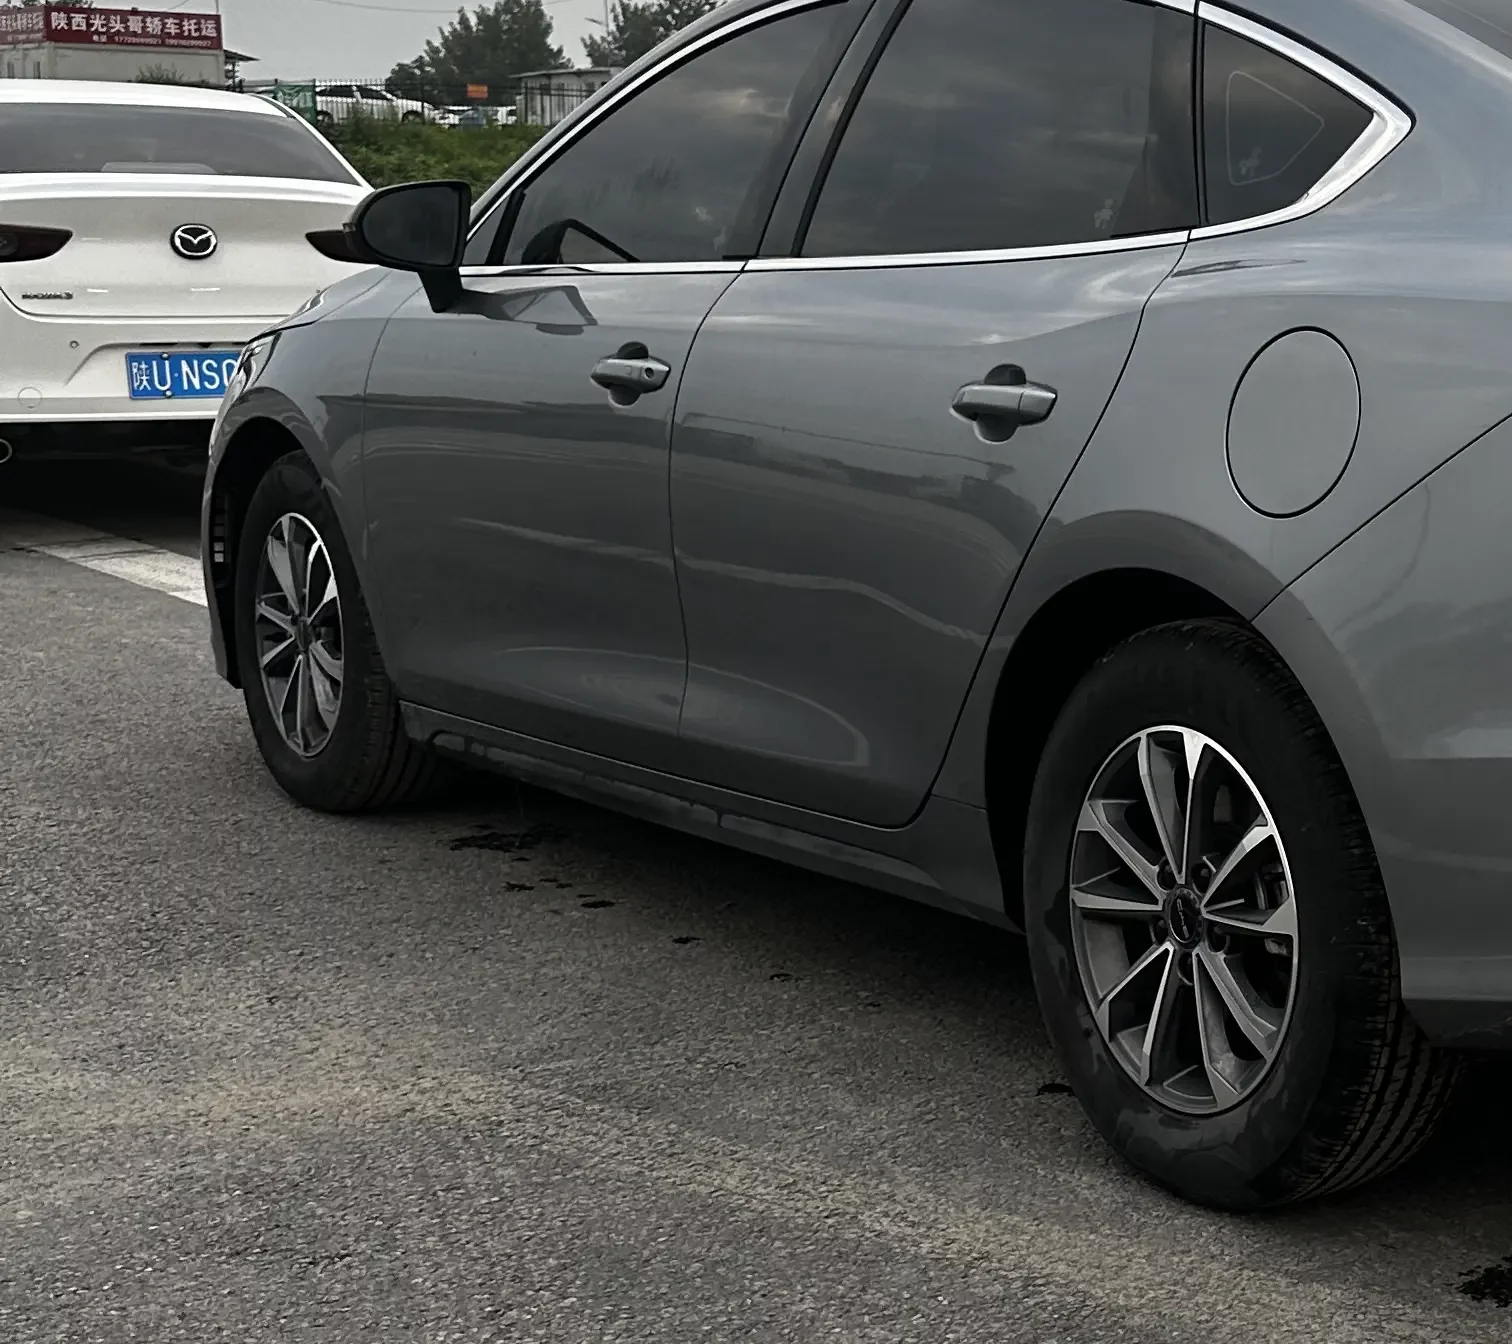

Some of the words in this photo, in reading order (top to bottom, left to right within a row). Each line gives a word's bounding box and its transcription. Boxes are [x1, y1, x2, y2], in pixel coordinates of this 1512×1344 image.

[51, 11, 217, 38] 陕西光头哥轿车托运
